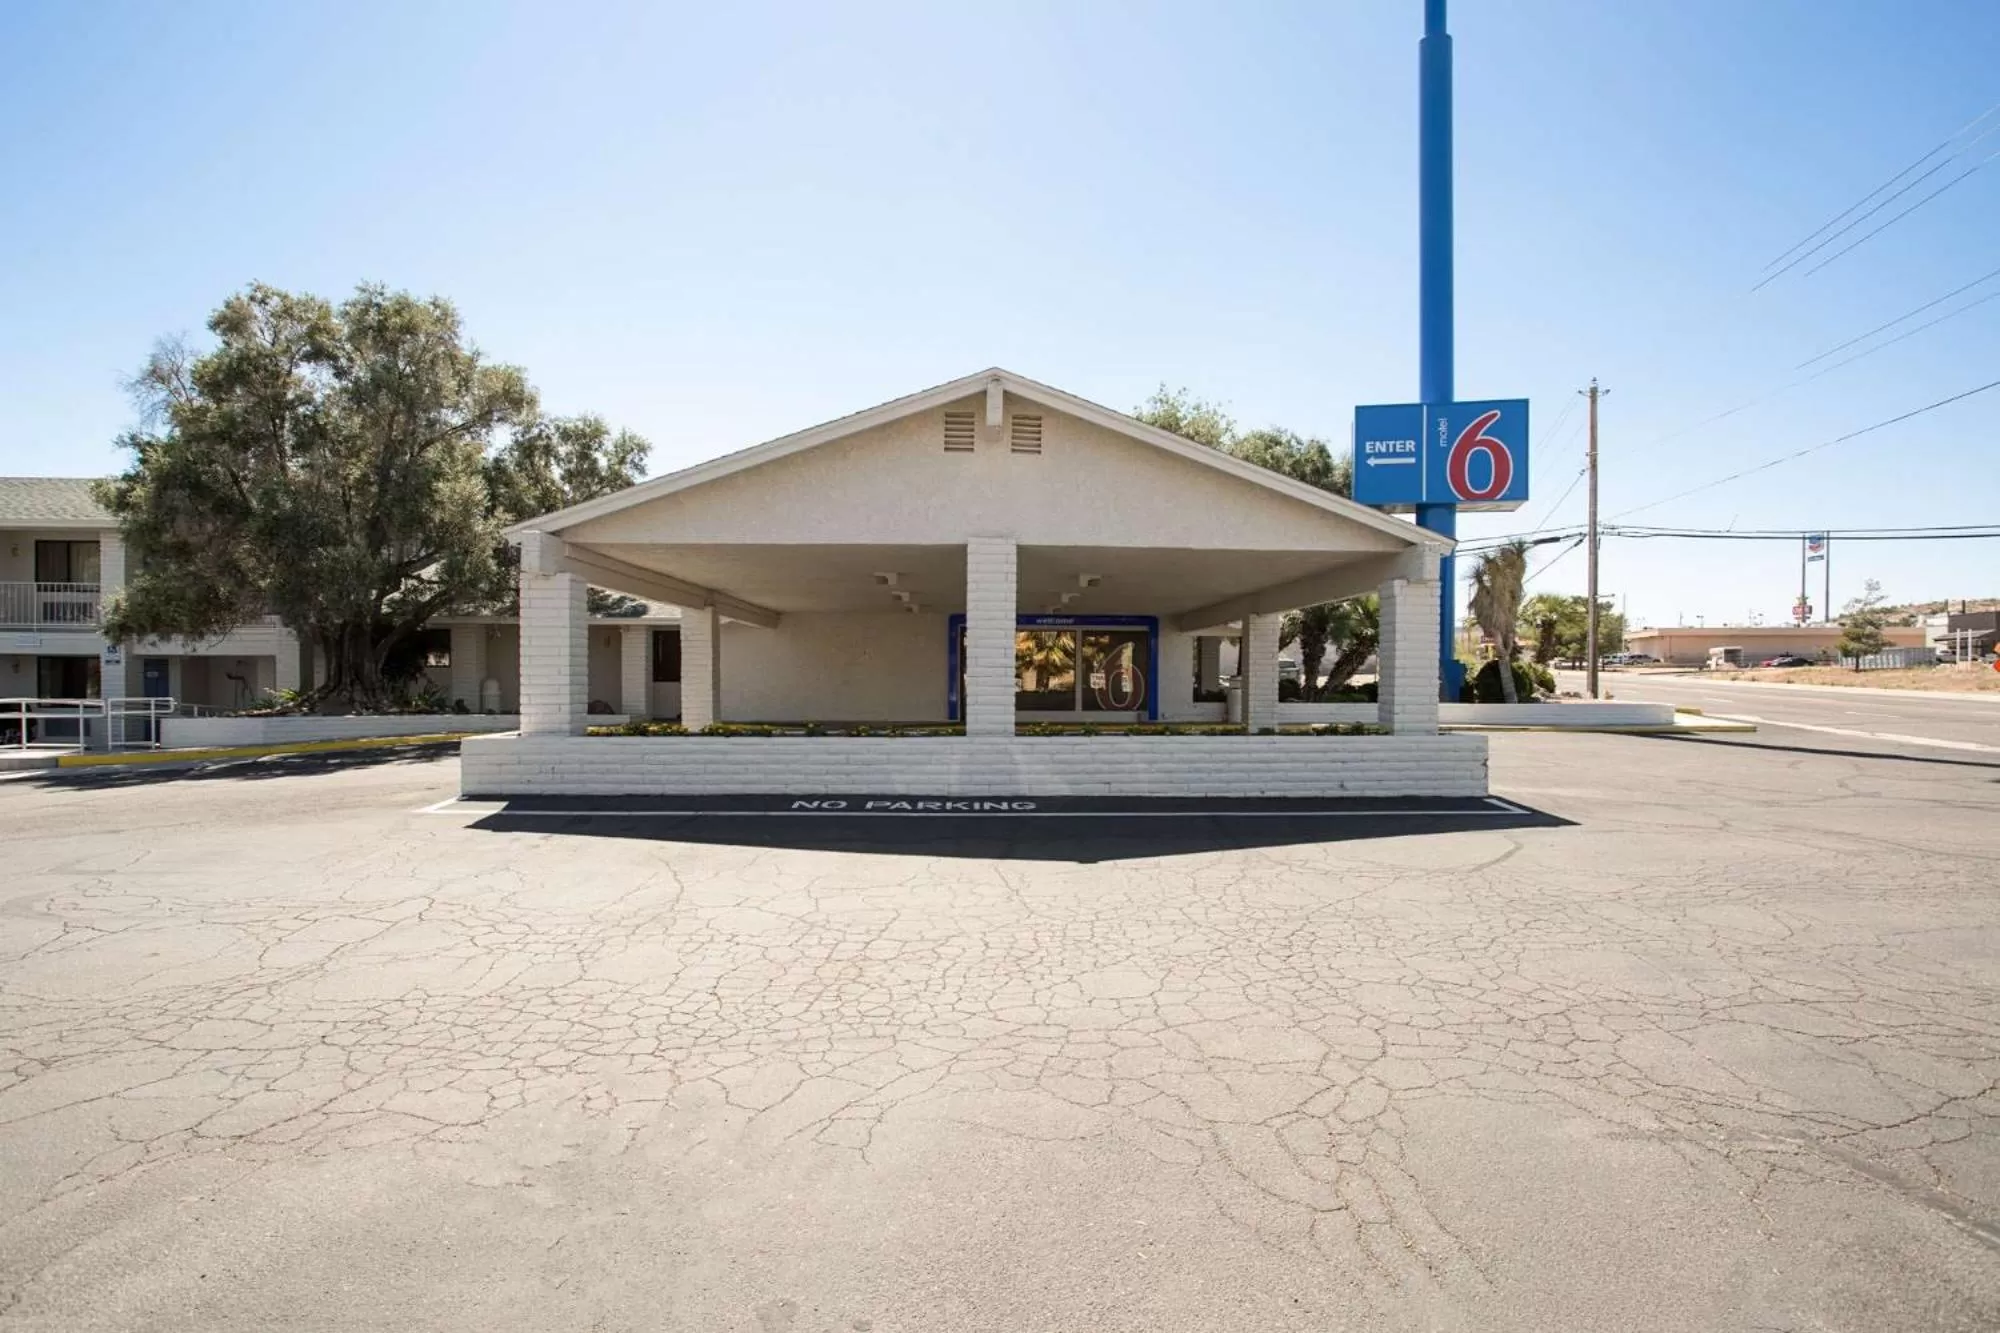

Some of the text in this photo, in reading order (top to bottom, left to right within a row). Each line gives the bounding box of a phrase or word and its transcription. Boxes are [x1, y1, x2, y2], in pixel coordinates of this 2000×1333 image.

[1365, 440, 1416, 453] ENTER
[1438, 410, 1513, 500] motel 6
[1095, 642, 1145, 710] 6
[791, 800, 1037, 810] NO PARKING
